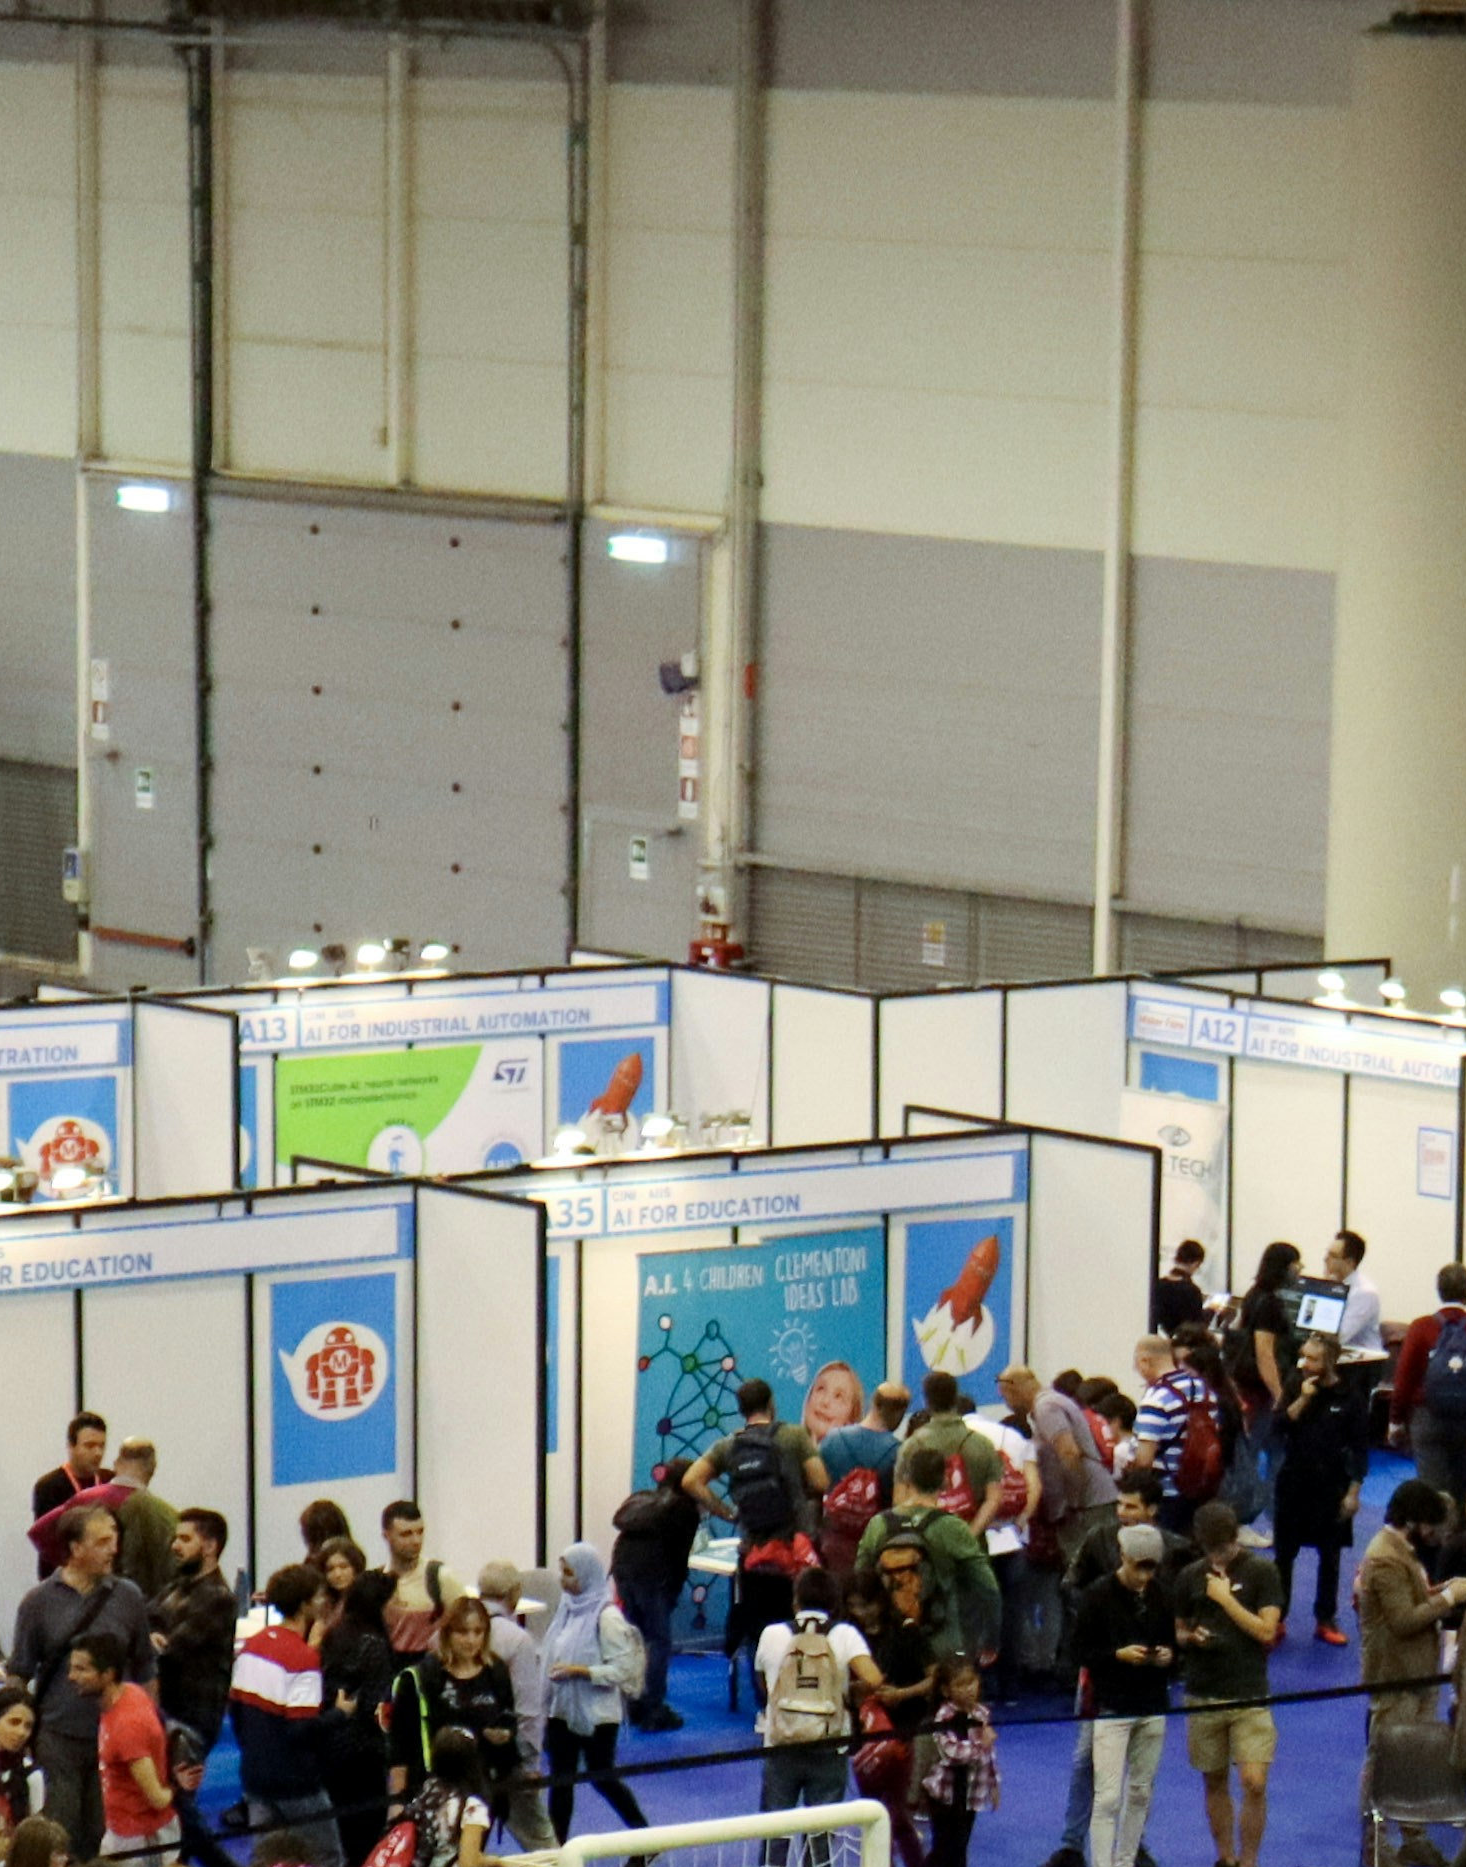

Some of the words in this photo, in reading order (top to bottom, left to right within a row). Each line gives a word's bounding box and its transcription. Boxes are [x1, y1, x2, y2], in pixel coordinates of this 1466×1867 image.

[240, 1017, 288, 1043] A13
[306, 1026, 323, 1042] AI
[328, 1024, 362, 1041] FOR
[367, 1016, 471, 1038] INDUSTRIAL
[476, 1008, 591, 1030] AUTOMATION
[1198, 1019, 1236, 1045] A12
[1251, 1037, 1268, 1053] AI
[1271, 1040, 1300, 1058] FOR
[1304, 1045, 1396, 1074] INDUSTRIAL
[547, 1196, 595, 1229] 35
[613, 1208, 632, 1228] AI
[639, 1205, 677, 1225] FOR
[685, 1194, 801, 1223] EDUCATION
[20, 1252, 154, 1284] EDUCATION
[699, 1263, 764, 1292] CHILDREN
[775, 1246, 868, 1282] CLEMENTONI
[784, 1282, 824, 1312] IDEAS
[831, 1276, 860, 1307] LAB
